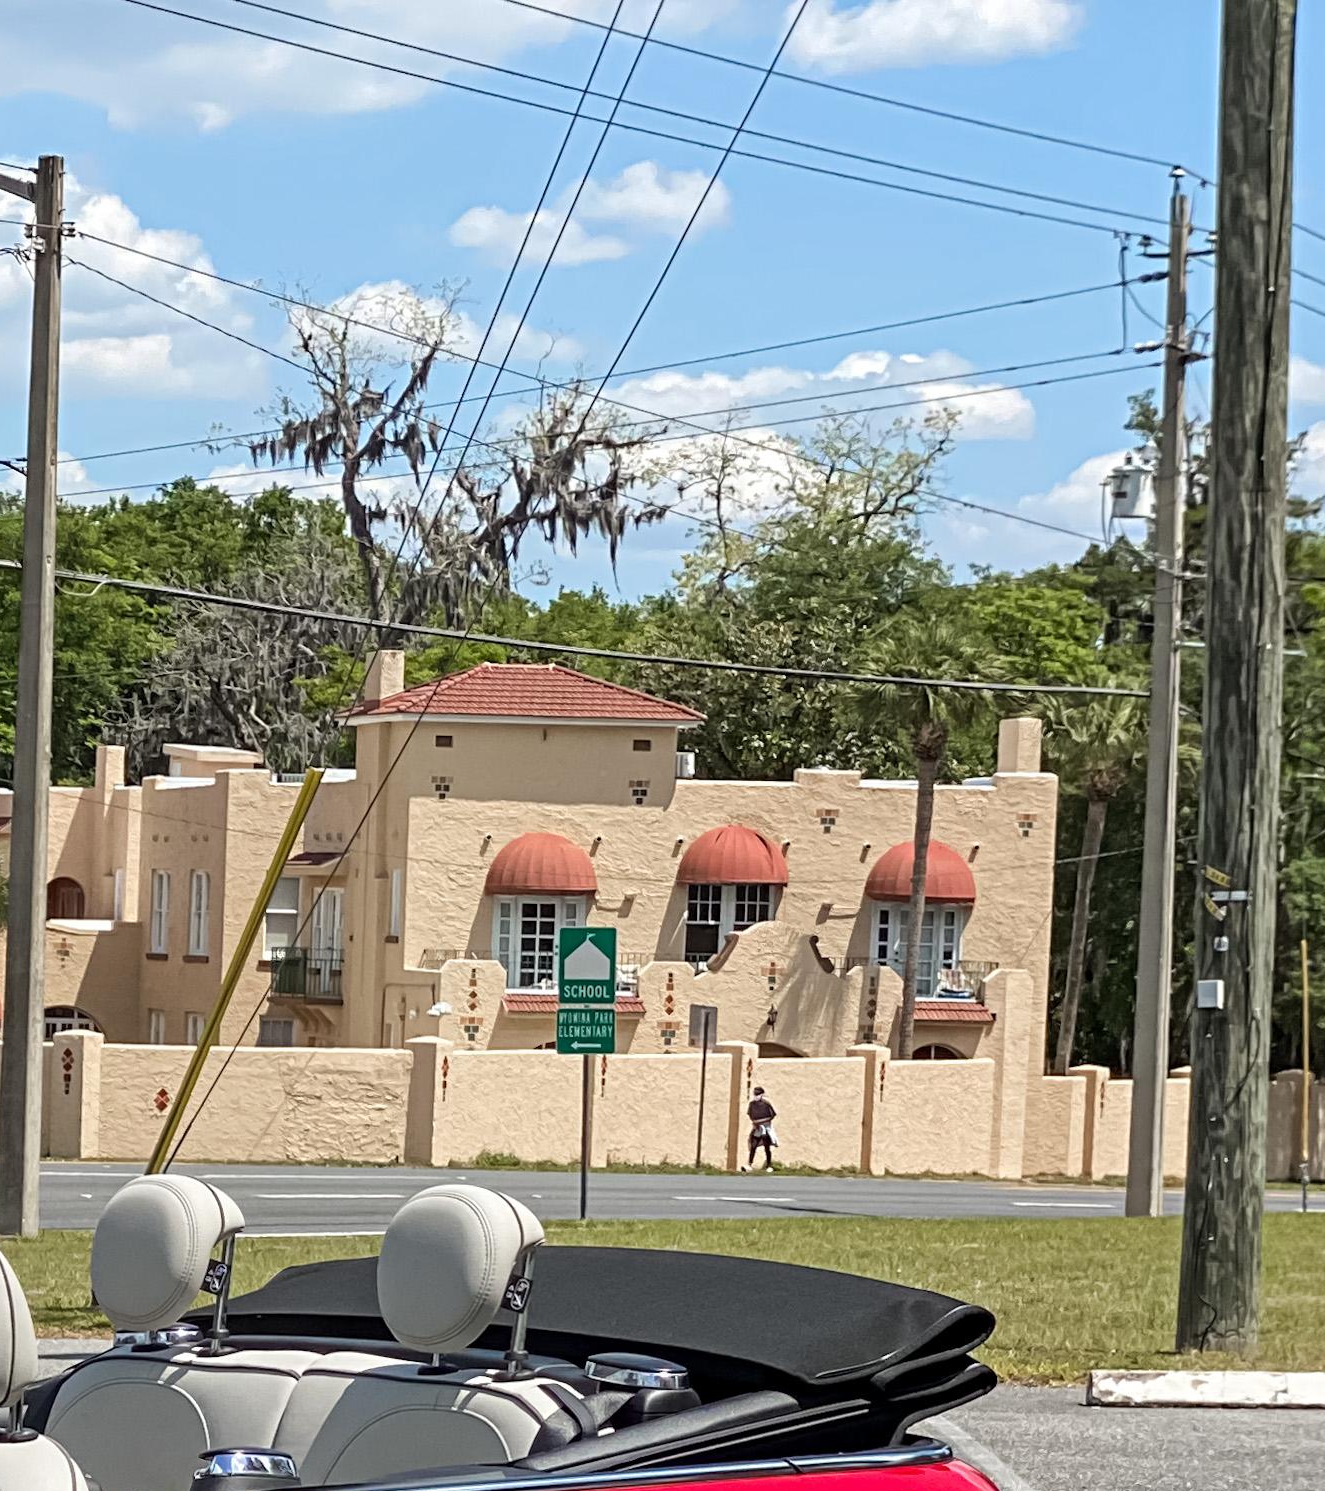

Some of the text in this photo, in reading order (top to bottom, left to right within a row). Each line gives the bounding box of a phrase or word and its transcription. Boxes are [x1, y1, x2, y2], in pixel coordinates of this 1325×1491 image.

[563, 985, 610, 998] SCHOOL
[594, 1011, 613, 1024] PARK
[558, 1025, 613, 1038] ELEMENTARY
